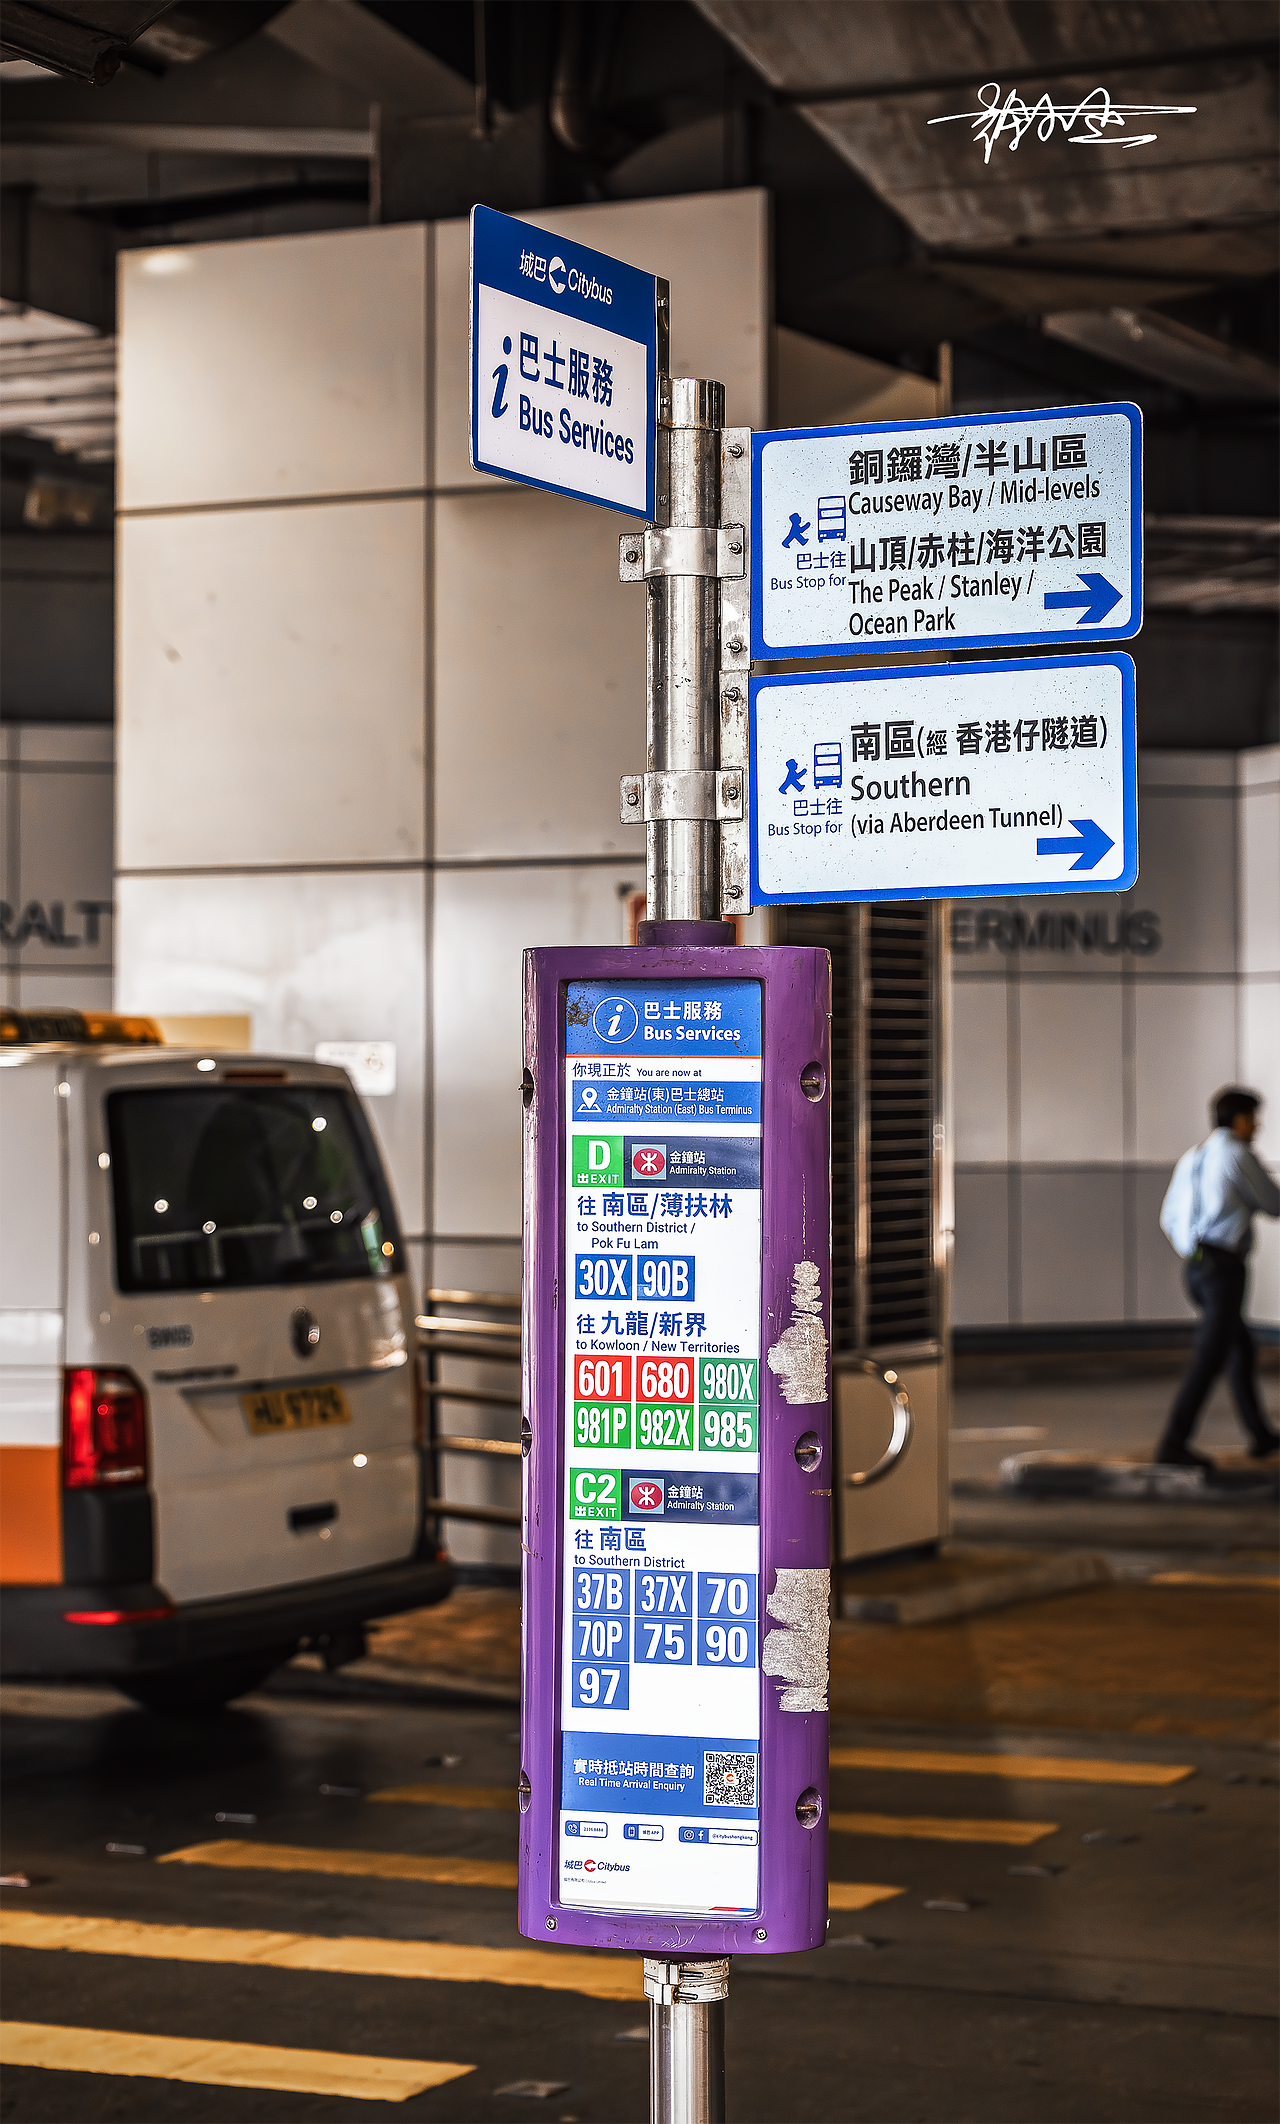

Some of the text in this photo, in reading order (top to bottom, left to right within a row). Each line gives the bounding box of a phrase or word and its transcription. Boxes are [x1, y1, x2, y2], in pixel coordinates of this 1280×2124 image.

[519, 249, 547, 283] 城巴
[567, 268, 614, 306] Citybus
[519, 331, 615, 408] 巴士服務
[519, 394, 634, 465] Bus Services
[848, 433, 1088, 486] 銅鑼灣/半山區
[848, 490, 946, 516] Causeway
[949, 486, 983, 516] Bay
[1000, 474, 1101, 505] Mid-levels
[849, 521, 1107, 574] 山頂/赤柱/海洋公園
[796, 550, 847, 570] 巴士往
[771, 573, 846, 591] Bus Stop for
[848, 579, 883, 605] The
[889, 576, 934, 601] Peak
[950, 572, 1020, 602] Stanley
[849, 607, 956, 637] Ocean Park
[851, 770, 971, 801] Southern
[793, 798, 843, 816] 巴士往
[768, 821, 843, 837] Bus Stop for
[851, 804, 1063, 839] (via Aberdeen Tunnel)
[644, 1001, 722, 1021] 巴士服務
[644, 1025, 741, 1041] Bus Services
[572, 1062, 632, 1078] 你現正於
[637, 1068, 653, 1077] You
[693, 1069, 702, 1077] at
[606, 1087, 725, 1102] 金鐘站(東)巴士總站
[606, 1104, 752, 1116] Admiralty Station (East) Bus Terminus
[588, 1140, 611, 1170] D
[669, 1151, 705, 1164] 金鐘站
[669, 1166, 737, 1176] Admiralty Station
[577, 1222, 589, 1232] to
[591, 1221, 643, 1233] Southern
[646, 1222, 688, 1234] District
[591, 1237, 659, 1250] Pok Fu Lam
[578, 1258, 690, 1298] 30X 90B
[576, 1340, 588, 1350] to
[590, 1339, 640, 1351] Kowloon
[651, 1340, 677, 1352] New
[680, 1341, 740, 1353] Territories
[578, 1360, 754, 1401] 601 680 980X
[577, 1406, 752, 1449] 981P 982X 985
[575, 1472, 616, 1504] C2
[667, 1485, 703, 1499] 金鐘站
[667, 1500, 735, 1511] Admiralty Station
[574, 1555, 685, 1568] to Southern District
[577, 1572, 749, 1616] 37B 37X 70
[578, 1620, 748, 1663] 70P 75 90
[579, 1667, 621, 1705] 97
[573, 1758, 695, 1780] 實時抵站時間查詢
[578, 1777, 686, 1793] Real Time Arrival Enquiry
[564, 1859, 583, 1870] 城巴
[597, 1861, 631, 1873] Citybus
